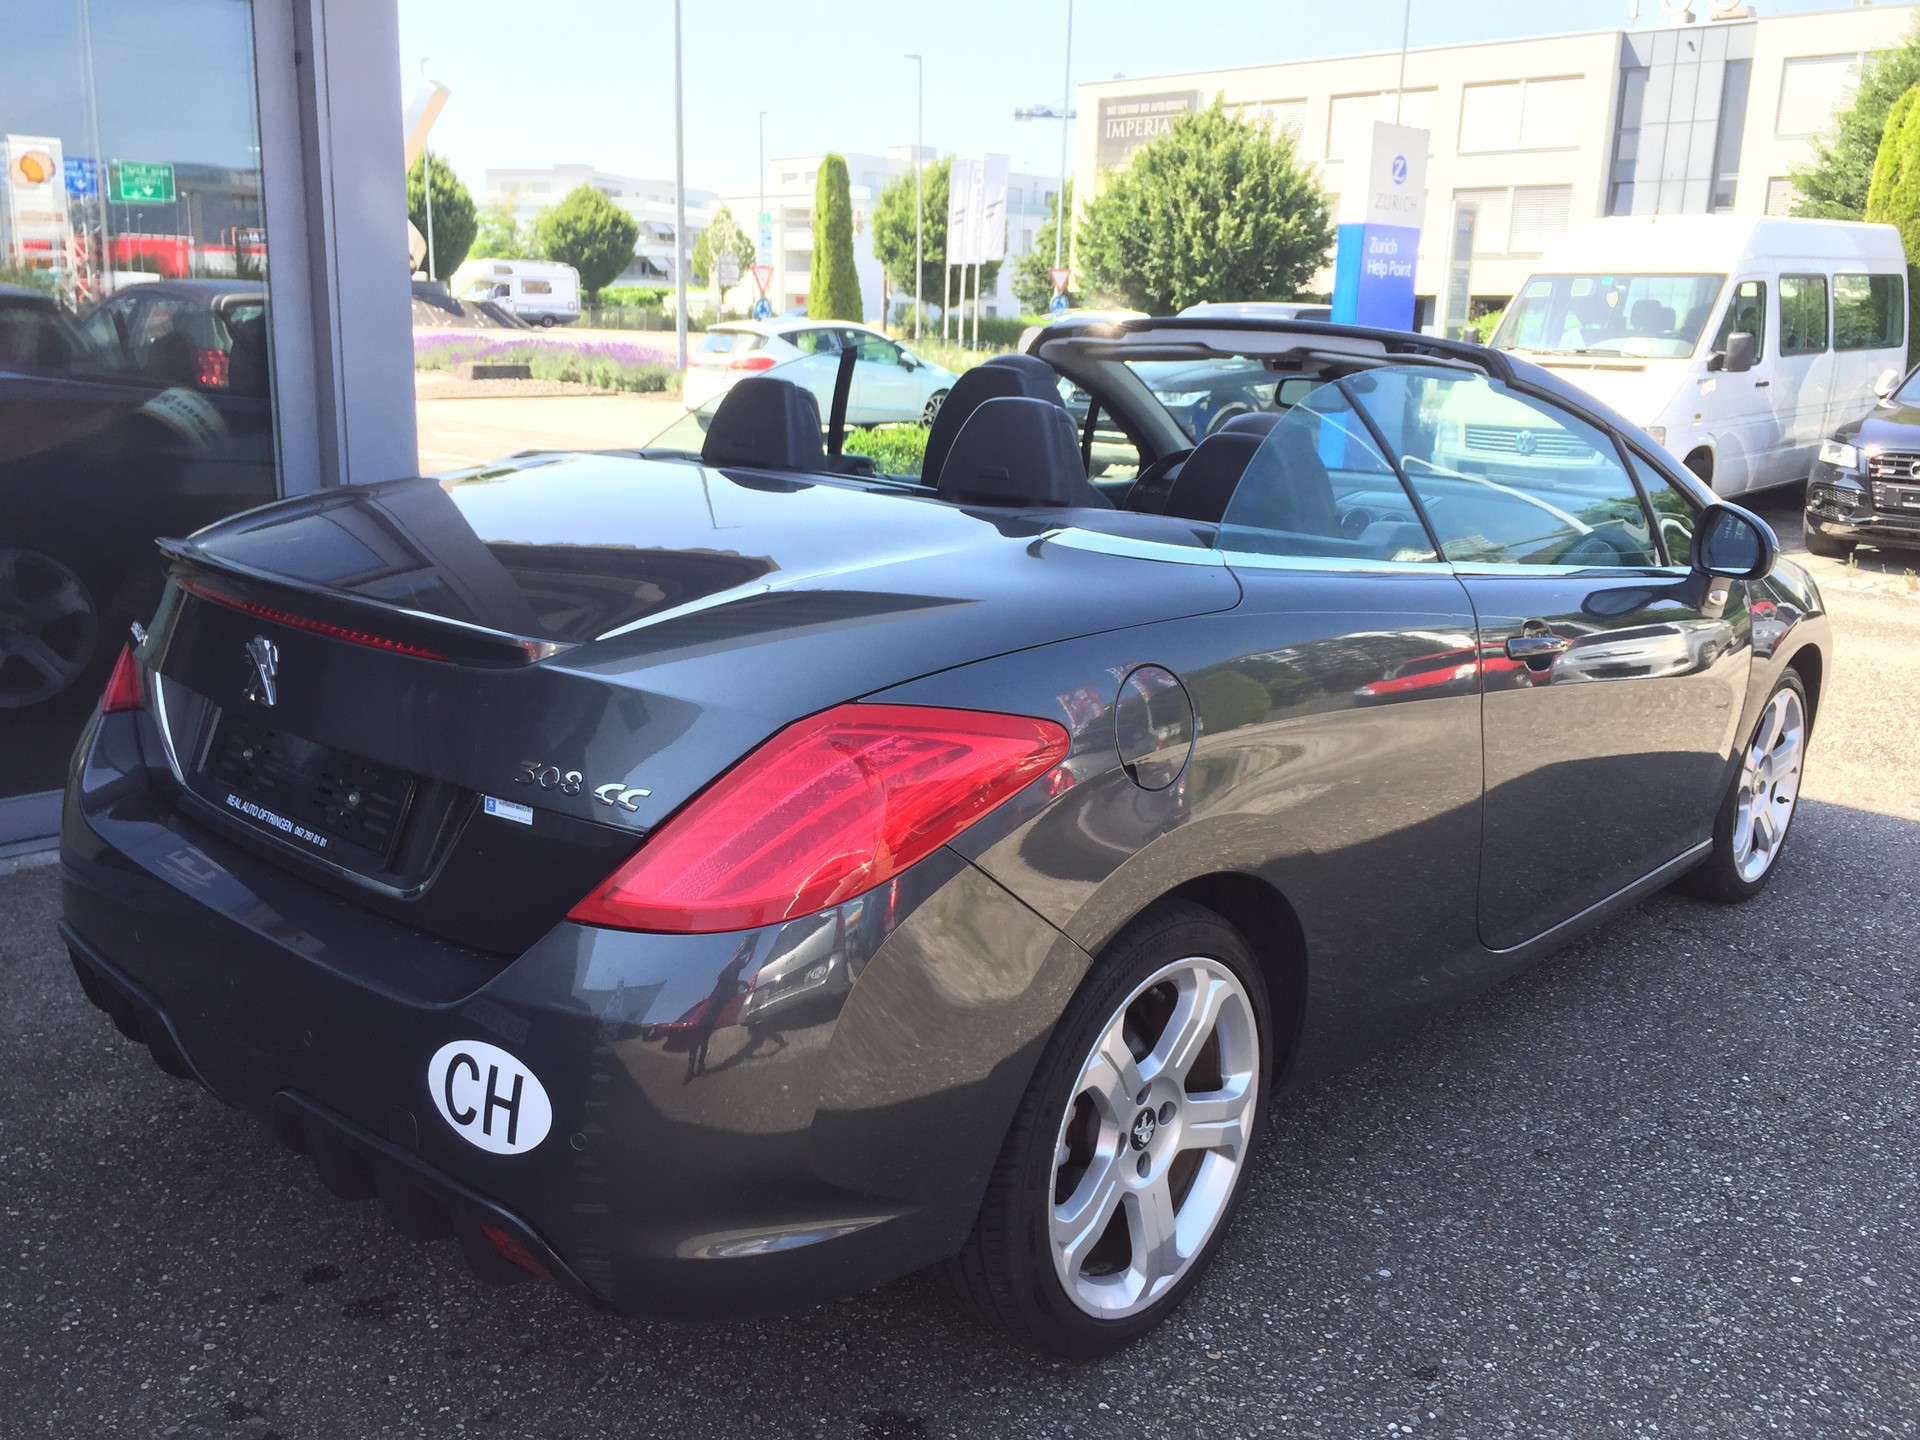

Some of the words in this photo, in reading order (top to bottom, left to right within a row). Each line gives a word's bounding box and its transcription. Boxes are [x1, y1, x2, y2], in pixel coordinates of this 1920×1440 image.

[1106, 118, 1171, 138] IMPERIA
[1375, 192, 1418, 212] ZURICH
[1369, 236, 1398, 255] Zurich
[1367, 259, 1388, 280] Help
[1389, 260, 1412, 277] Point
[514, 760, 584, 796] 308
[593, 783, 653, 812] CC
[226, 794, 241, 809] REAL
[240, 801, 259, 817] AUTO
[257, 808, 294, 833] OFTRINGEN
[444, 1052, 525, 1146] CH
